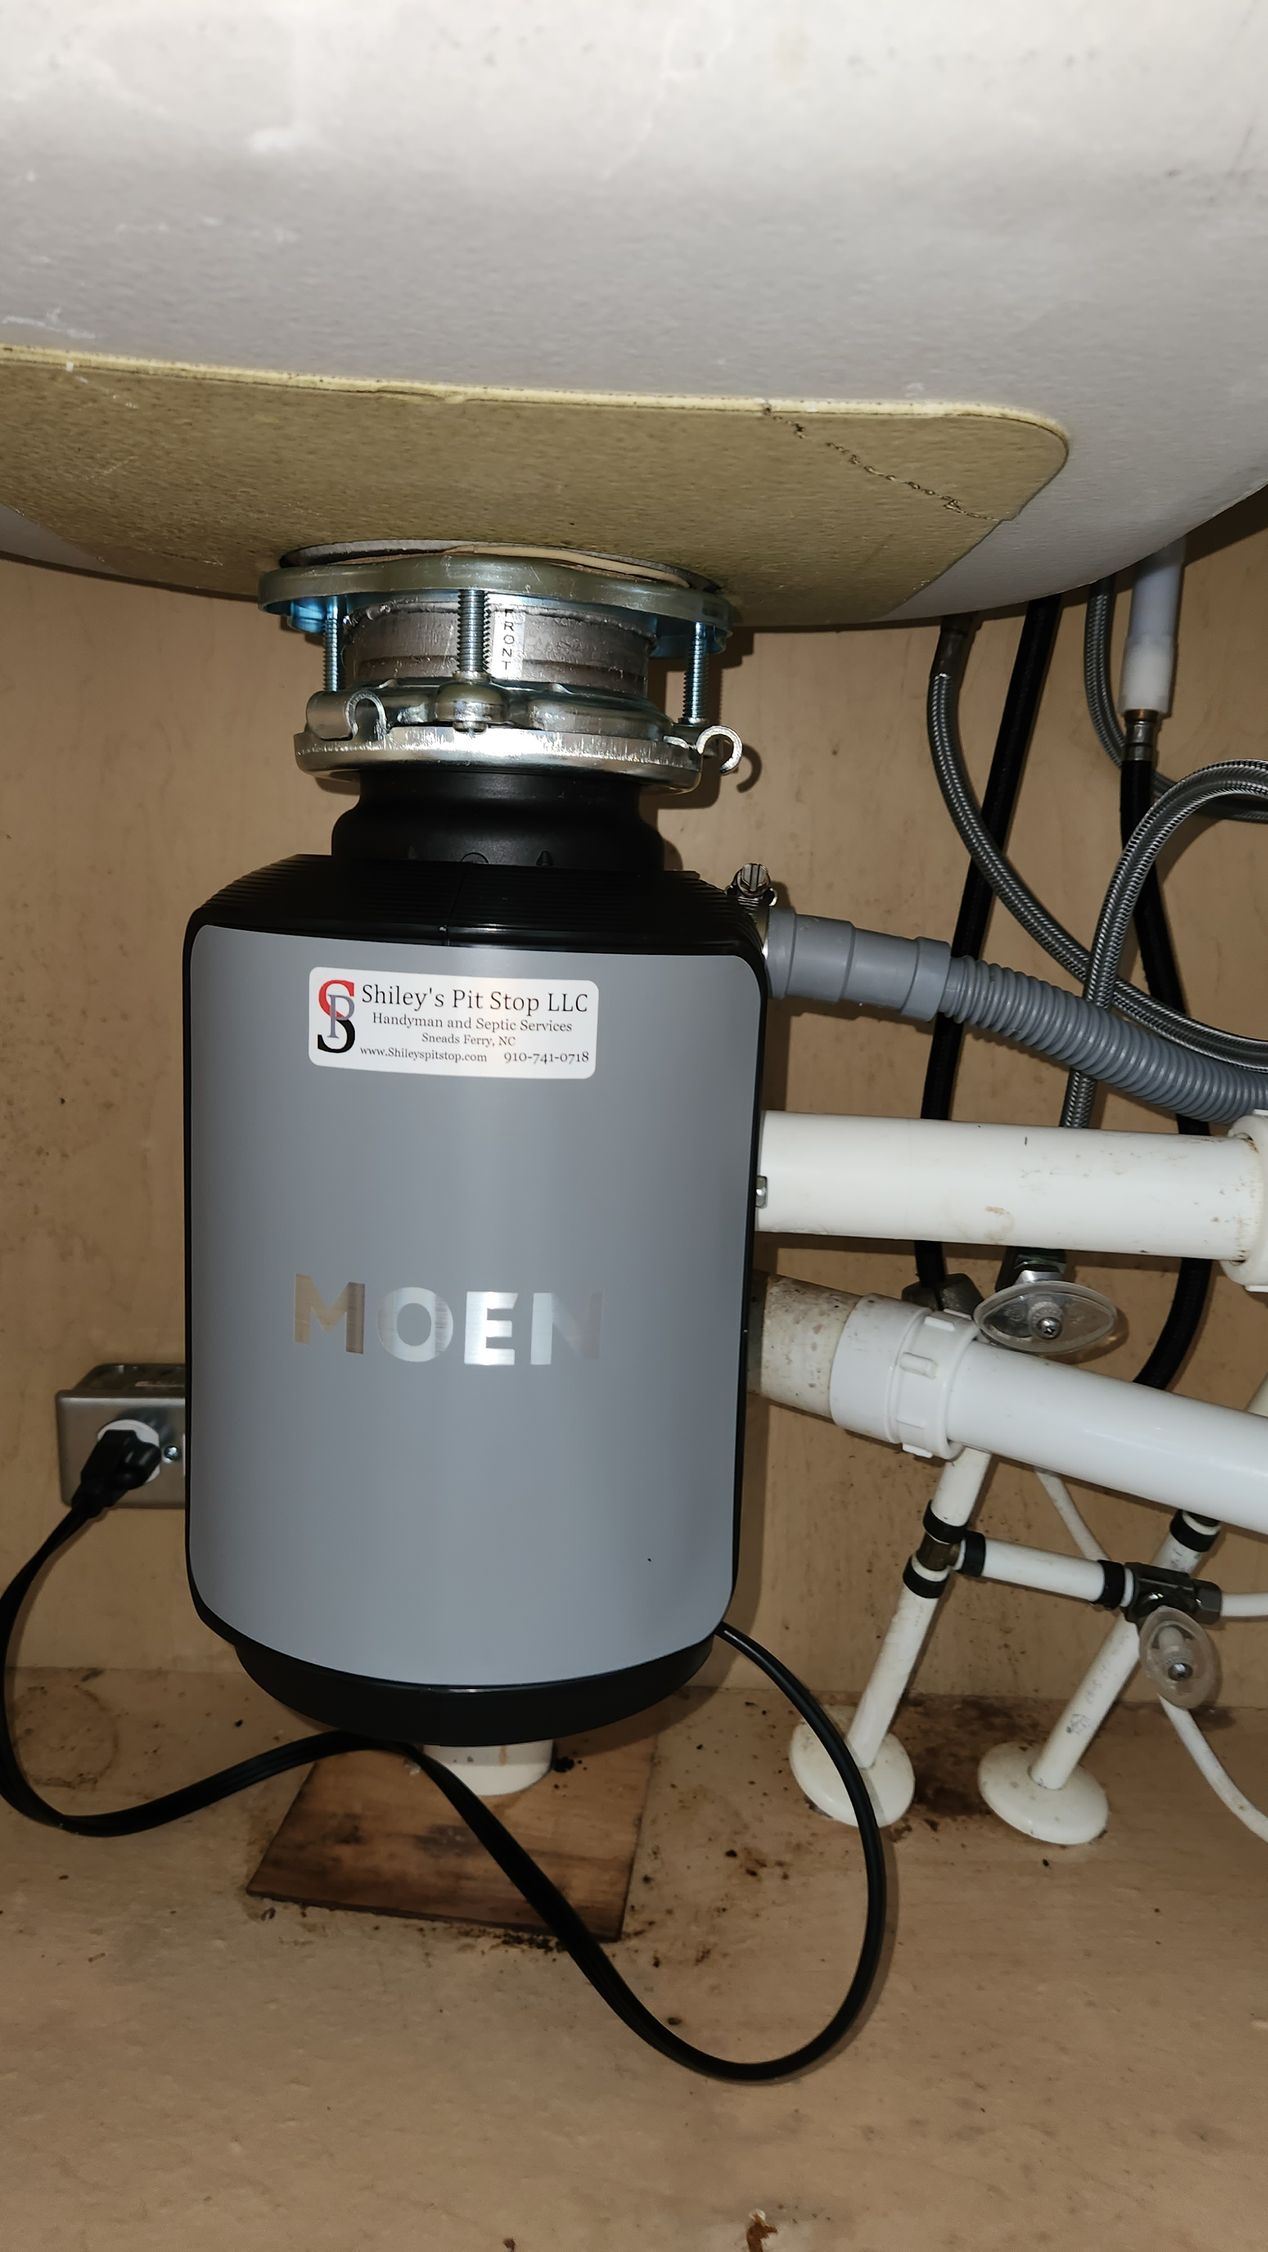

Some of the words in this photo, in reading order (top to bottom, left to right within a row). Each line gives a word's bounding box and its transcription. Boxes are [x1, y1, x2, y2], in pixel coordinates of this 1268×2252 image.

[361, 984, 445, 1012] Shiley's
[452, 989, 484, 1009] Pit
[490, 991, 540, 1017] Stop
[548, 992, 588, 1012] LLC
[373, 1012, 443, 1029] Handyman
[447, 1017, 472, 1029] and
[476, 1018, 516, 1033] Septic
[520, 1019, 573, 1032] Services
[421, 1032, 460, 1045] Sneads
[463, 1034, 495, 1048] Ferry,
[498, 1036, 516, 1046] NC
[360, 1046, 487, 1063] www.Shileyspitstop.com
[504, 1051, 589, 1064] 910-741-0718
[294, 1273, 603, 1366] MOEN
